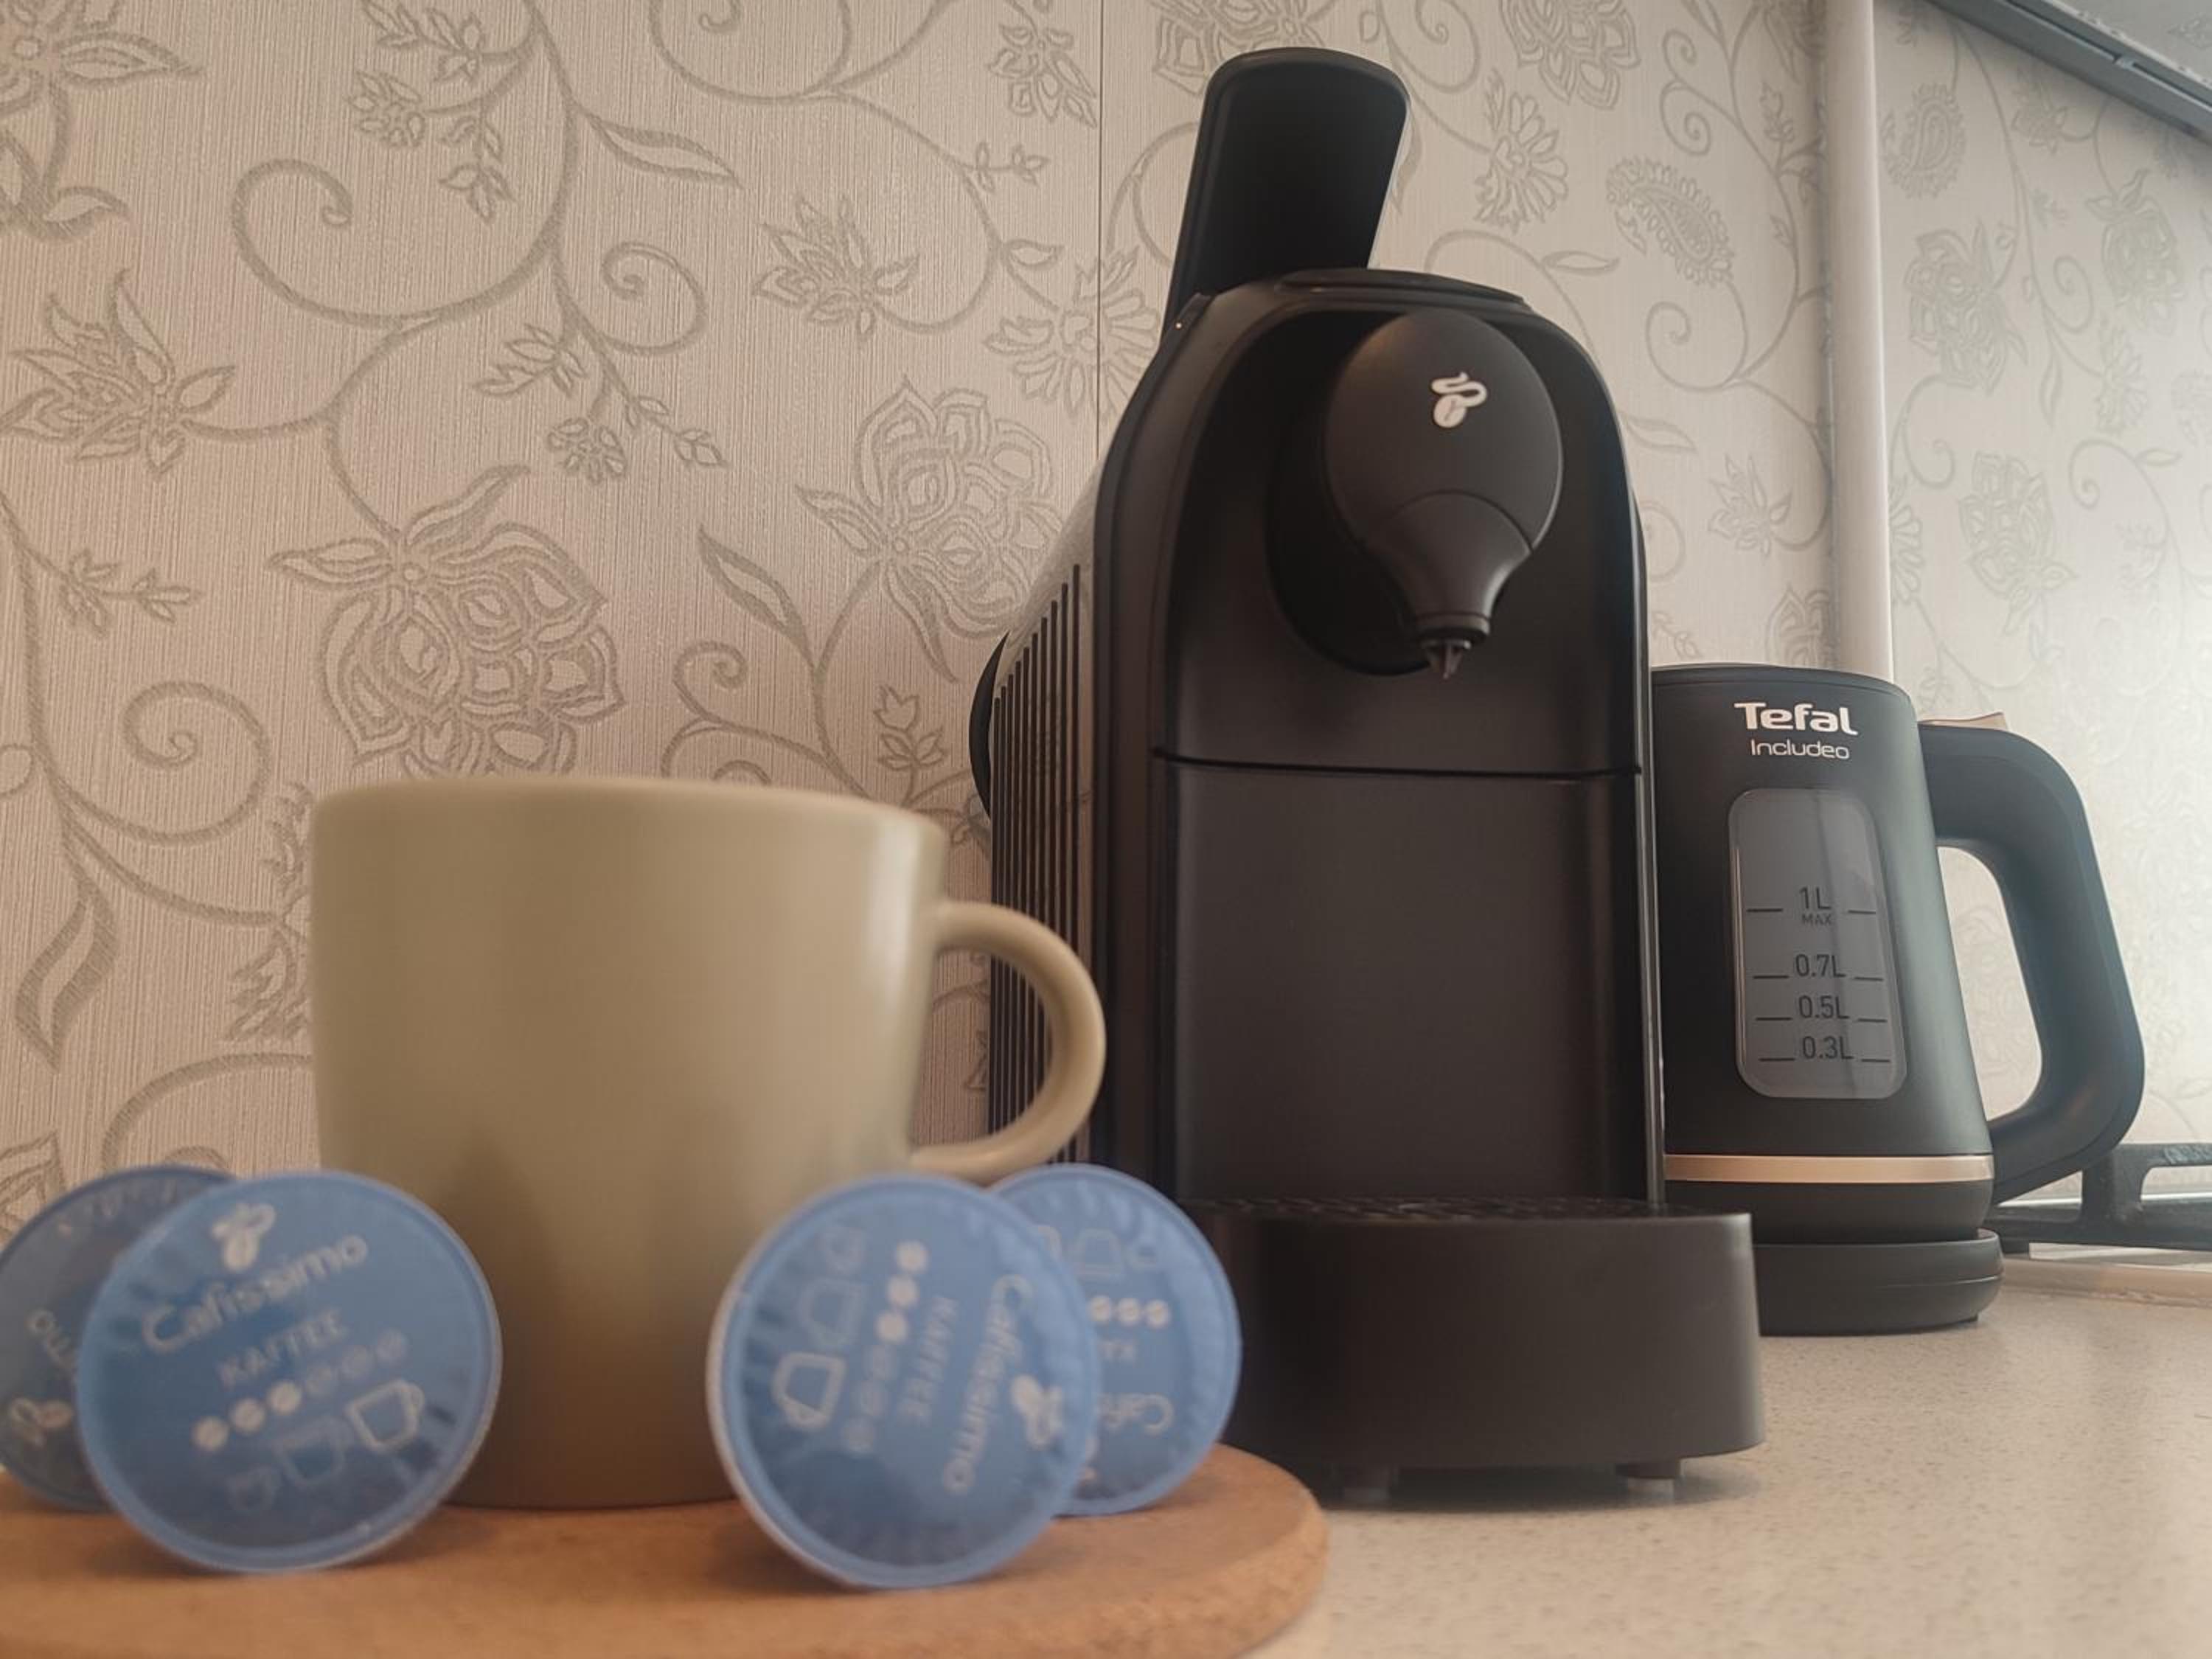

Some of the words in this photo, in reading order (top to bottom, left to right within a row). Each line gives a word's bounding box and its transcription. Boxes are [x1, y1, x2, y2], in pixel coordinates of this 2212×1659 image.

[1733, 702, 1859, 736] Tefal
[1750, 739, 1851, 760] Includeo
[1801, 913, 1832, 925] MAX
[1795, 953, 1847, 978] 0.7L
[1798, 995, 1850, 1020] 0.5L
[1802, 1035, 1854, 1060] 0.3L
[143, 1235, 369, 1353] Cafissimo
[217, 1307, 344, 1388] KAFFEE
